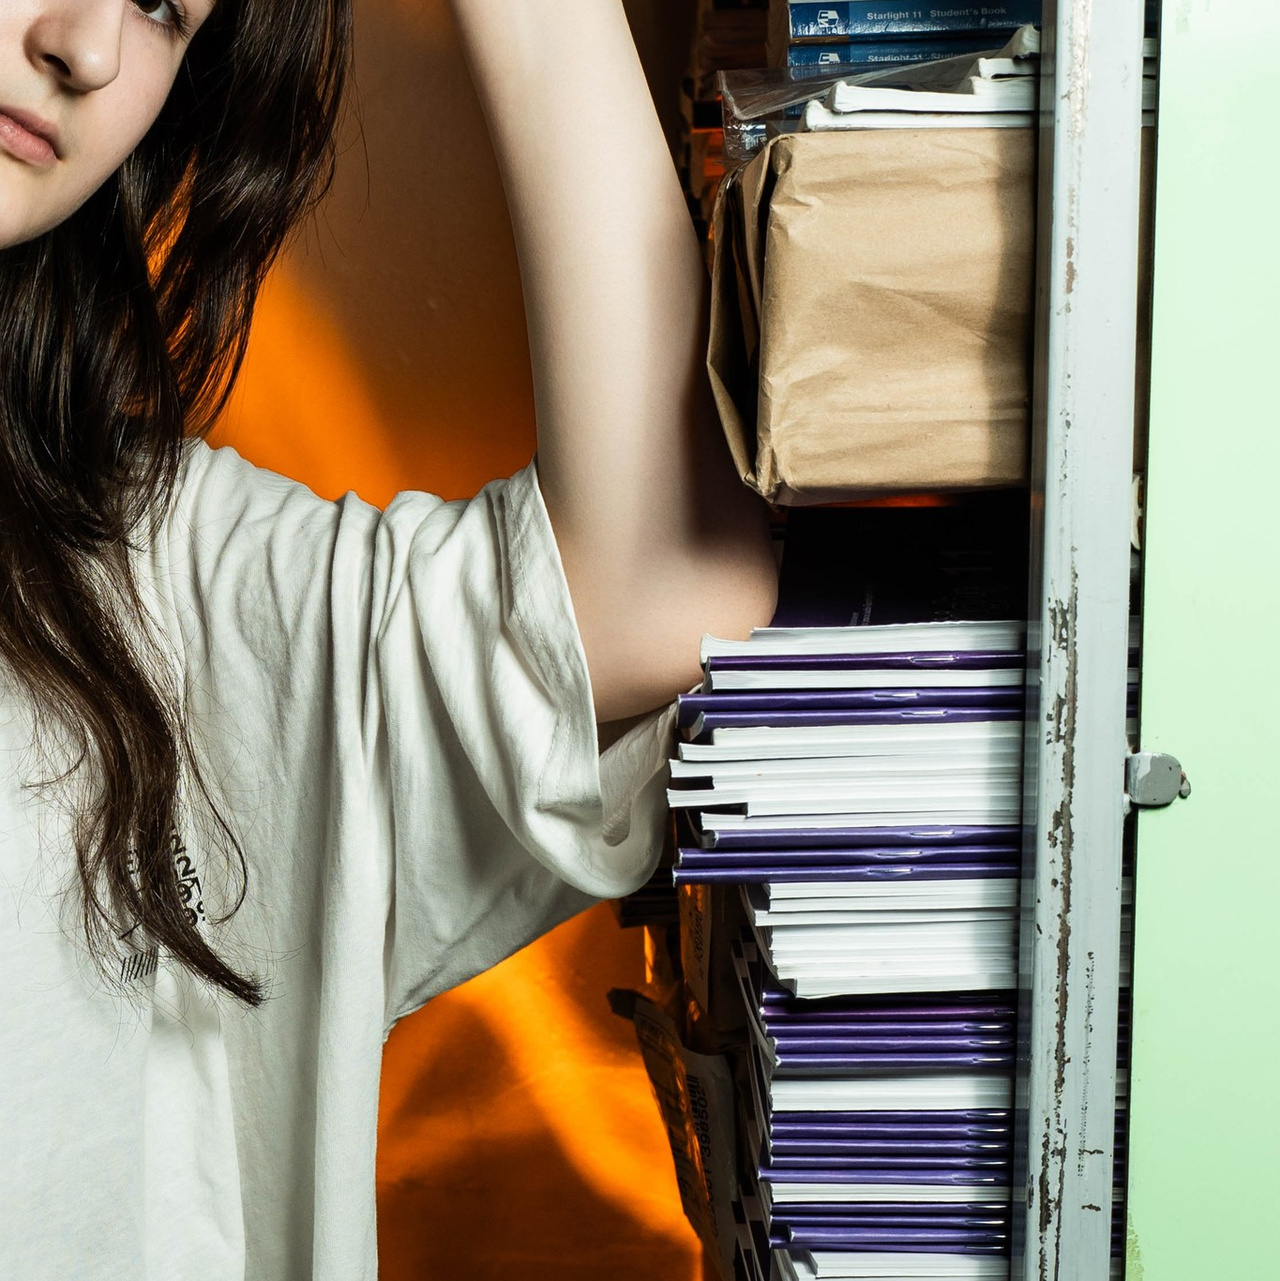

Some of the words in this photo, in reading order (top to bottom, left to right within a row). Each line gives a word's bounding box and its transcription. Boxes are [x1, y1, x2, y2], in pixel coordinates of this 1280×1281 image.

[866, 11, 910, 21] Starlight
[912, 10, 922, 19] 11
[929, 8, 979, 18] Student's
[980, 6, 1007, 16] Book
